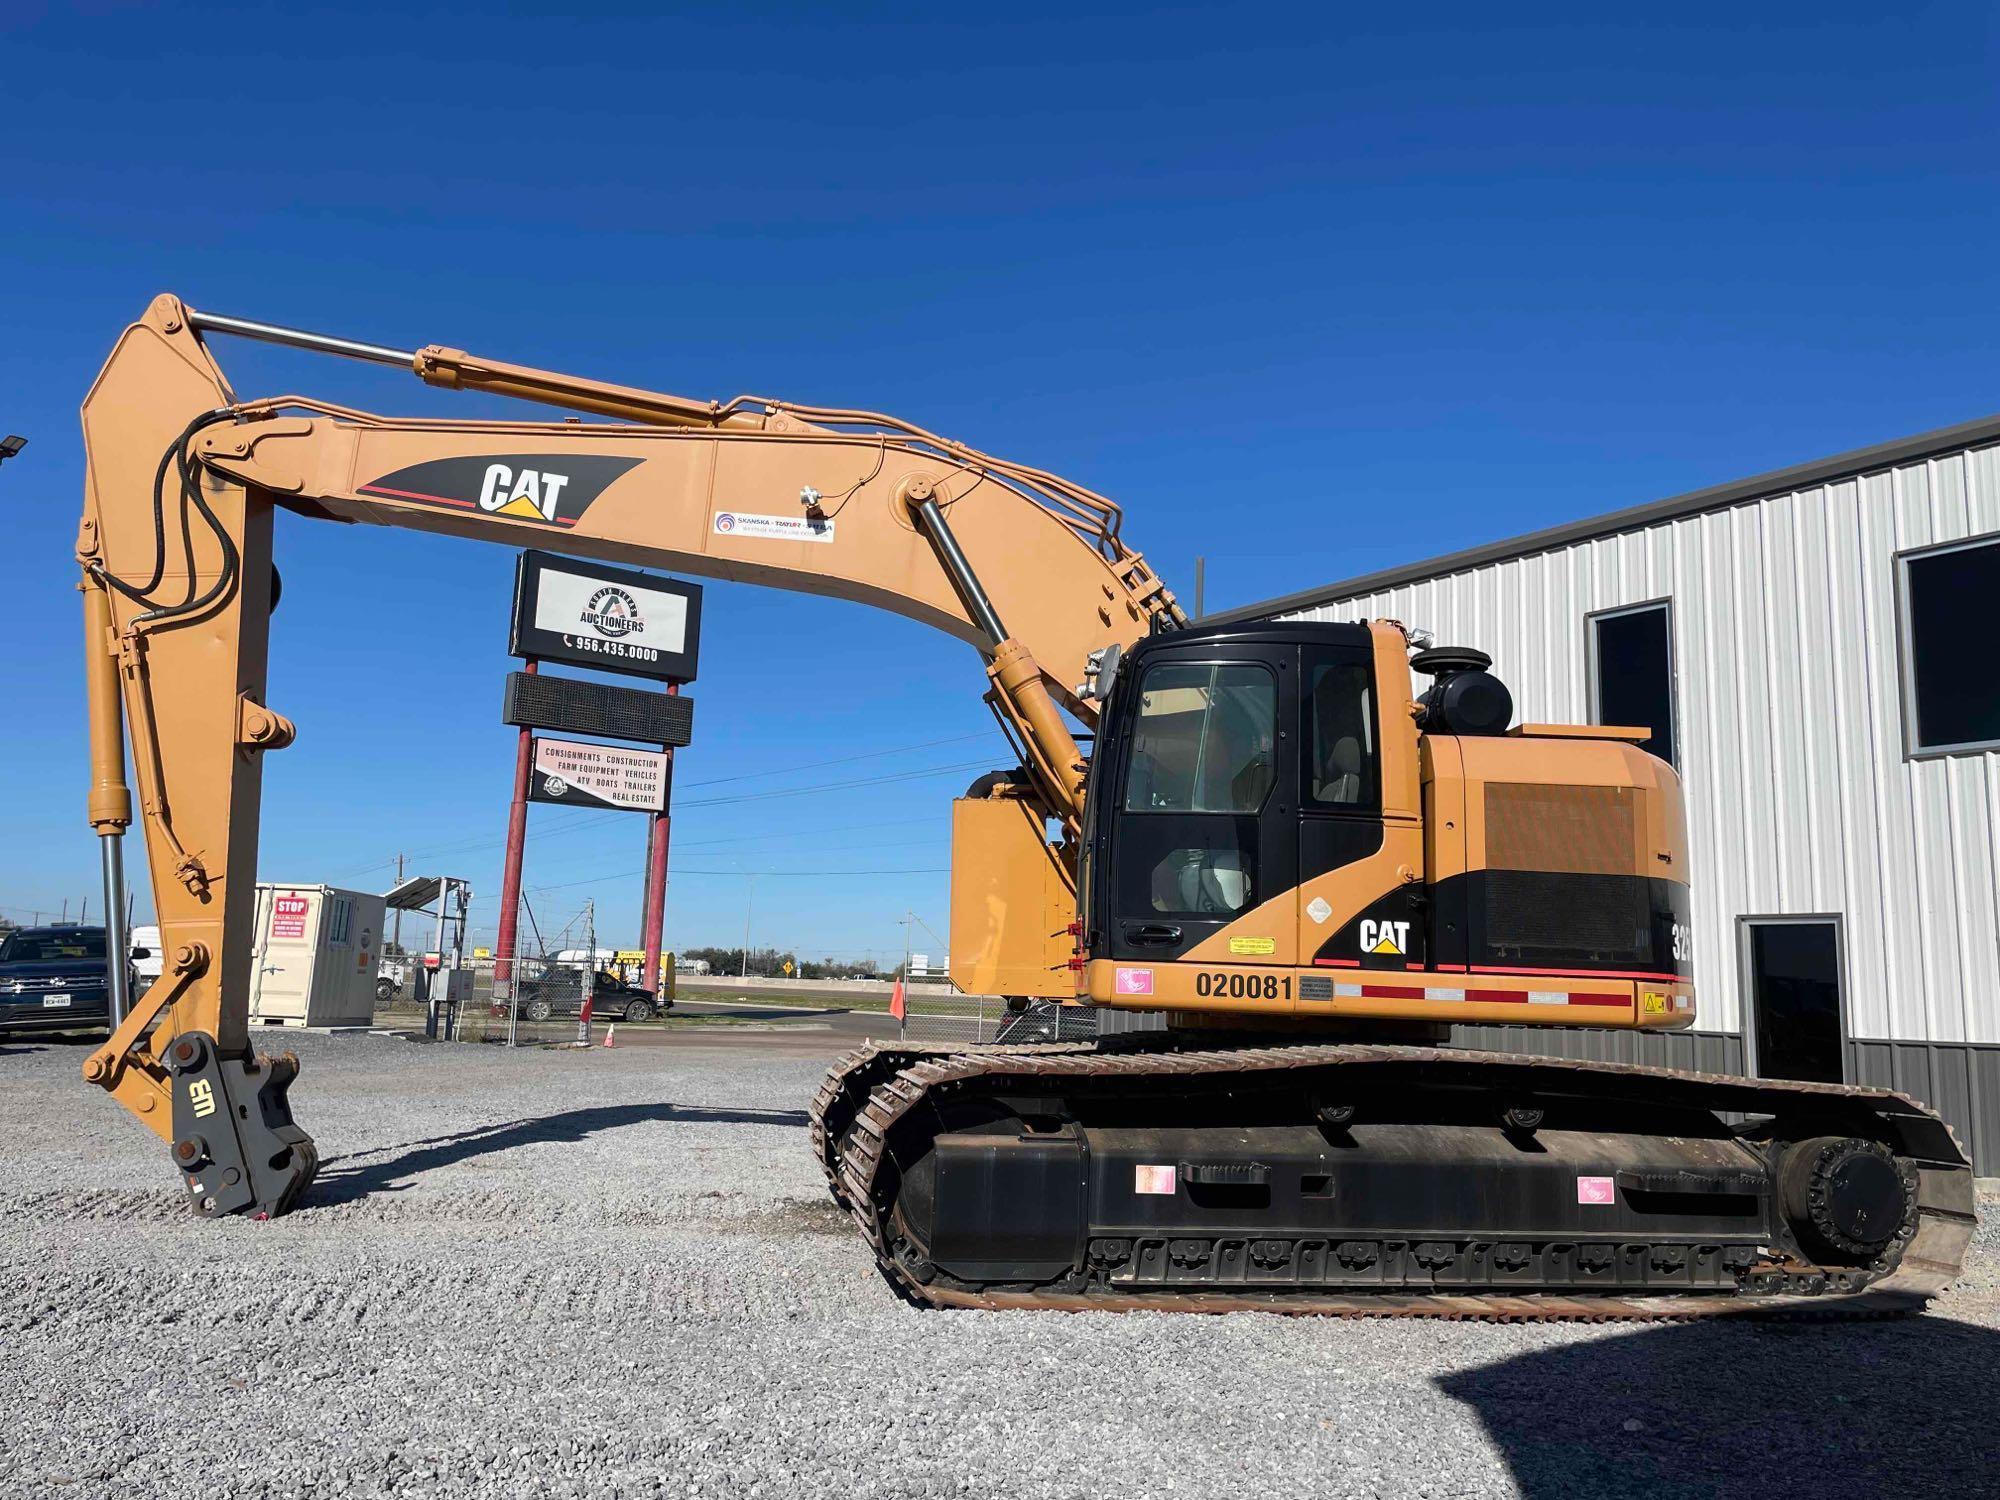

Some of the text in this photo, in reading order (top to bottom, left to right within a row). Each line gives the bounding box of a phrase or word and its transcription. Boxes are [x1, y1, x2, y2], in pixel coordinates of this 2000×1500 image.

[478, 463, 569, 521] CAT
[738, 517, 770, 525] SKANSKA
[580, 612, 645, 633] AUCTIONEERS
[576, 636, 658, 662] 956.435.0000
[545, 747, 658, 768] CONSIGNMENTS CONSTRUCTION
[558, 761, 657, 780] FARM EQUIPMENT VEHICLES
[576, 777, 657, 792] ATV BOATS TRAILERS
[612, 792, 656, 804] REAL ESTATE
[278, 901, 305, 912] STOP
[1360, 919, 1410, 955] CAT
[1196, 972, 1292, 1000] 020081
